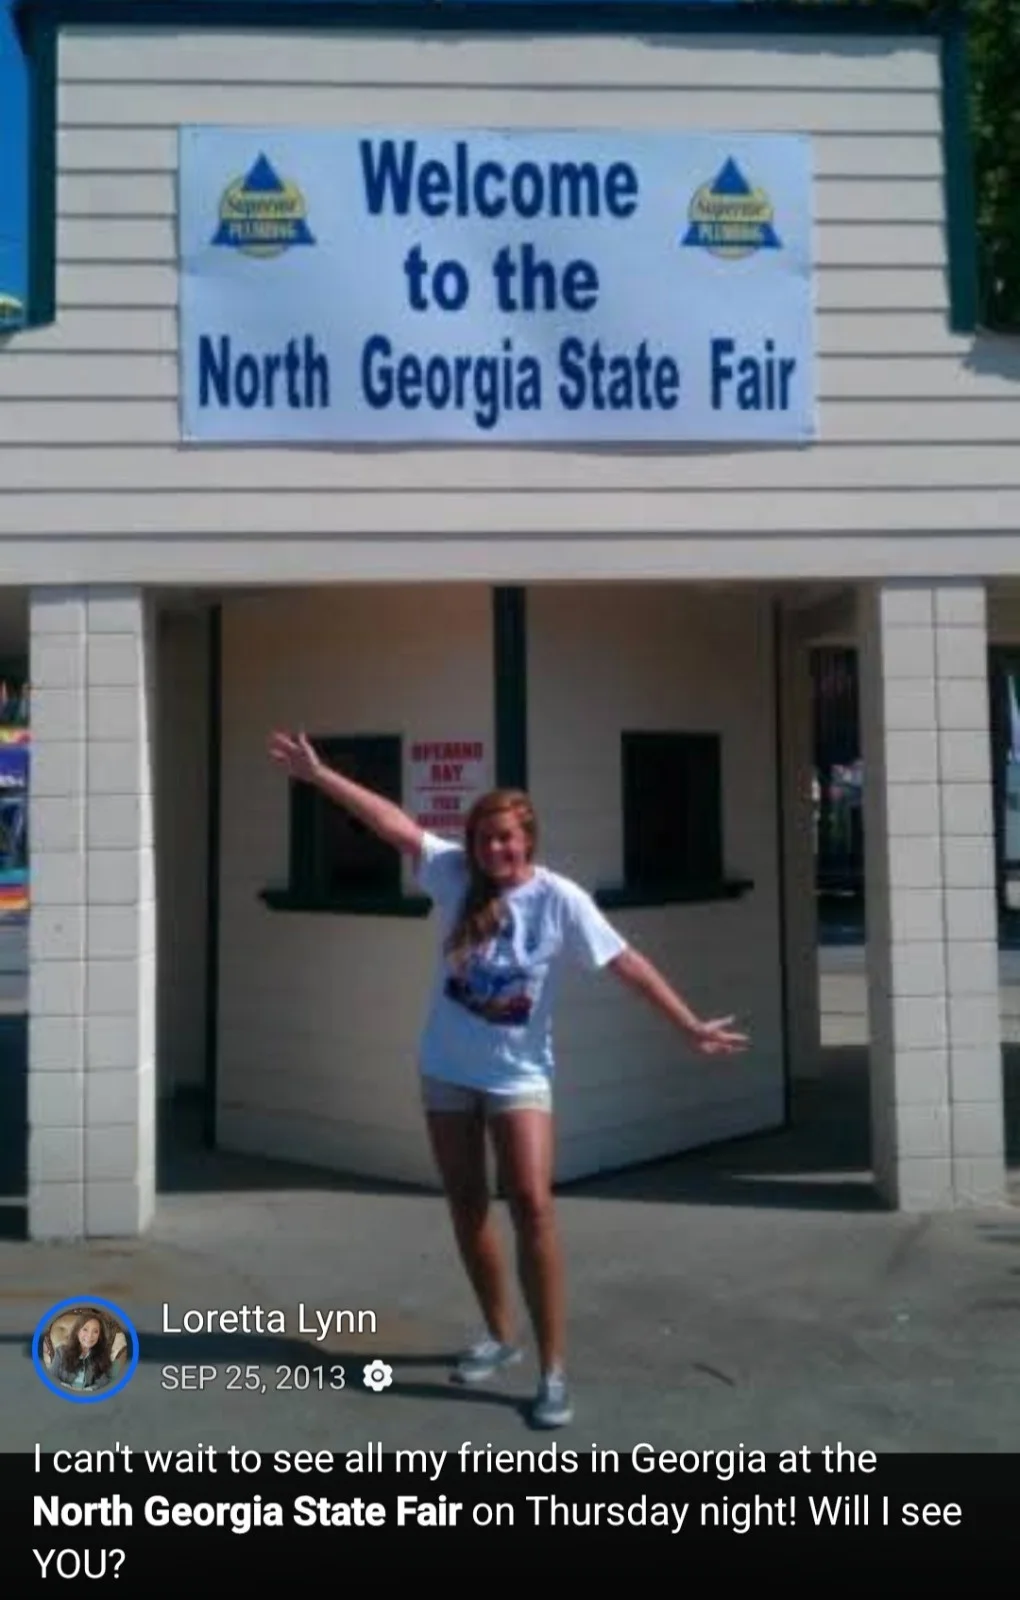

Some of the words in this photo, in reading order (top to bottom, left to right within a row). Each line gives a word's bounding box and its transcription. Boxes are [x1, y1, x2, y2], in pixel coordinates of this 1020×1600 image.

[360, 139, 638, 219] Welcome
[405, 246, 469, 311] to
[493, 243, 599, 313] the
[198, 334, 329, 409] North
[361, 334, 541, 430] Georgia
[558, 336, 680, 411] State
[711, 338, 796, 411] Fair
